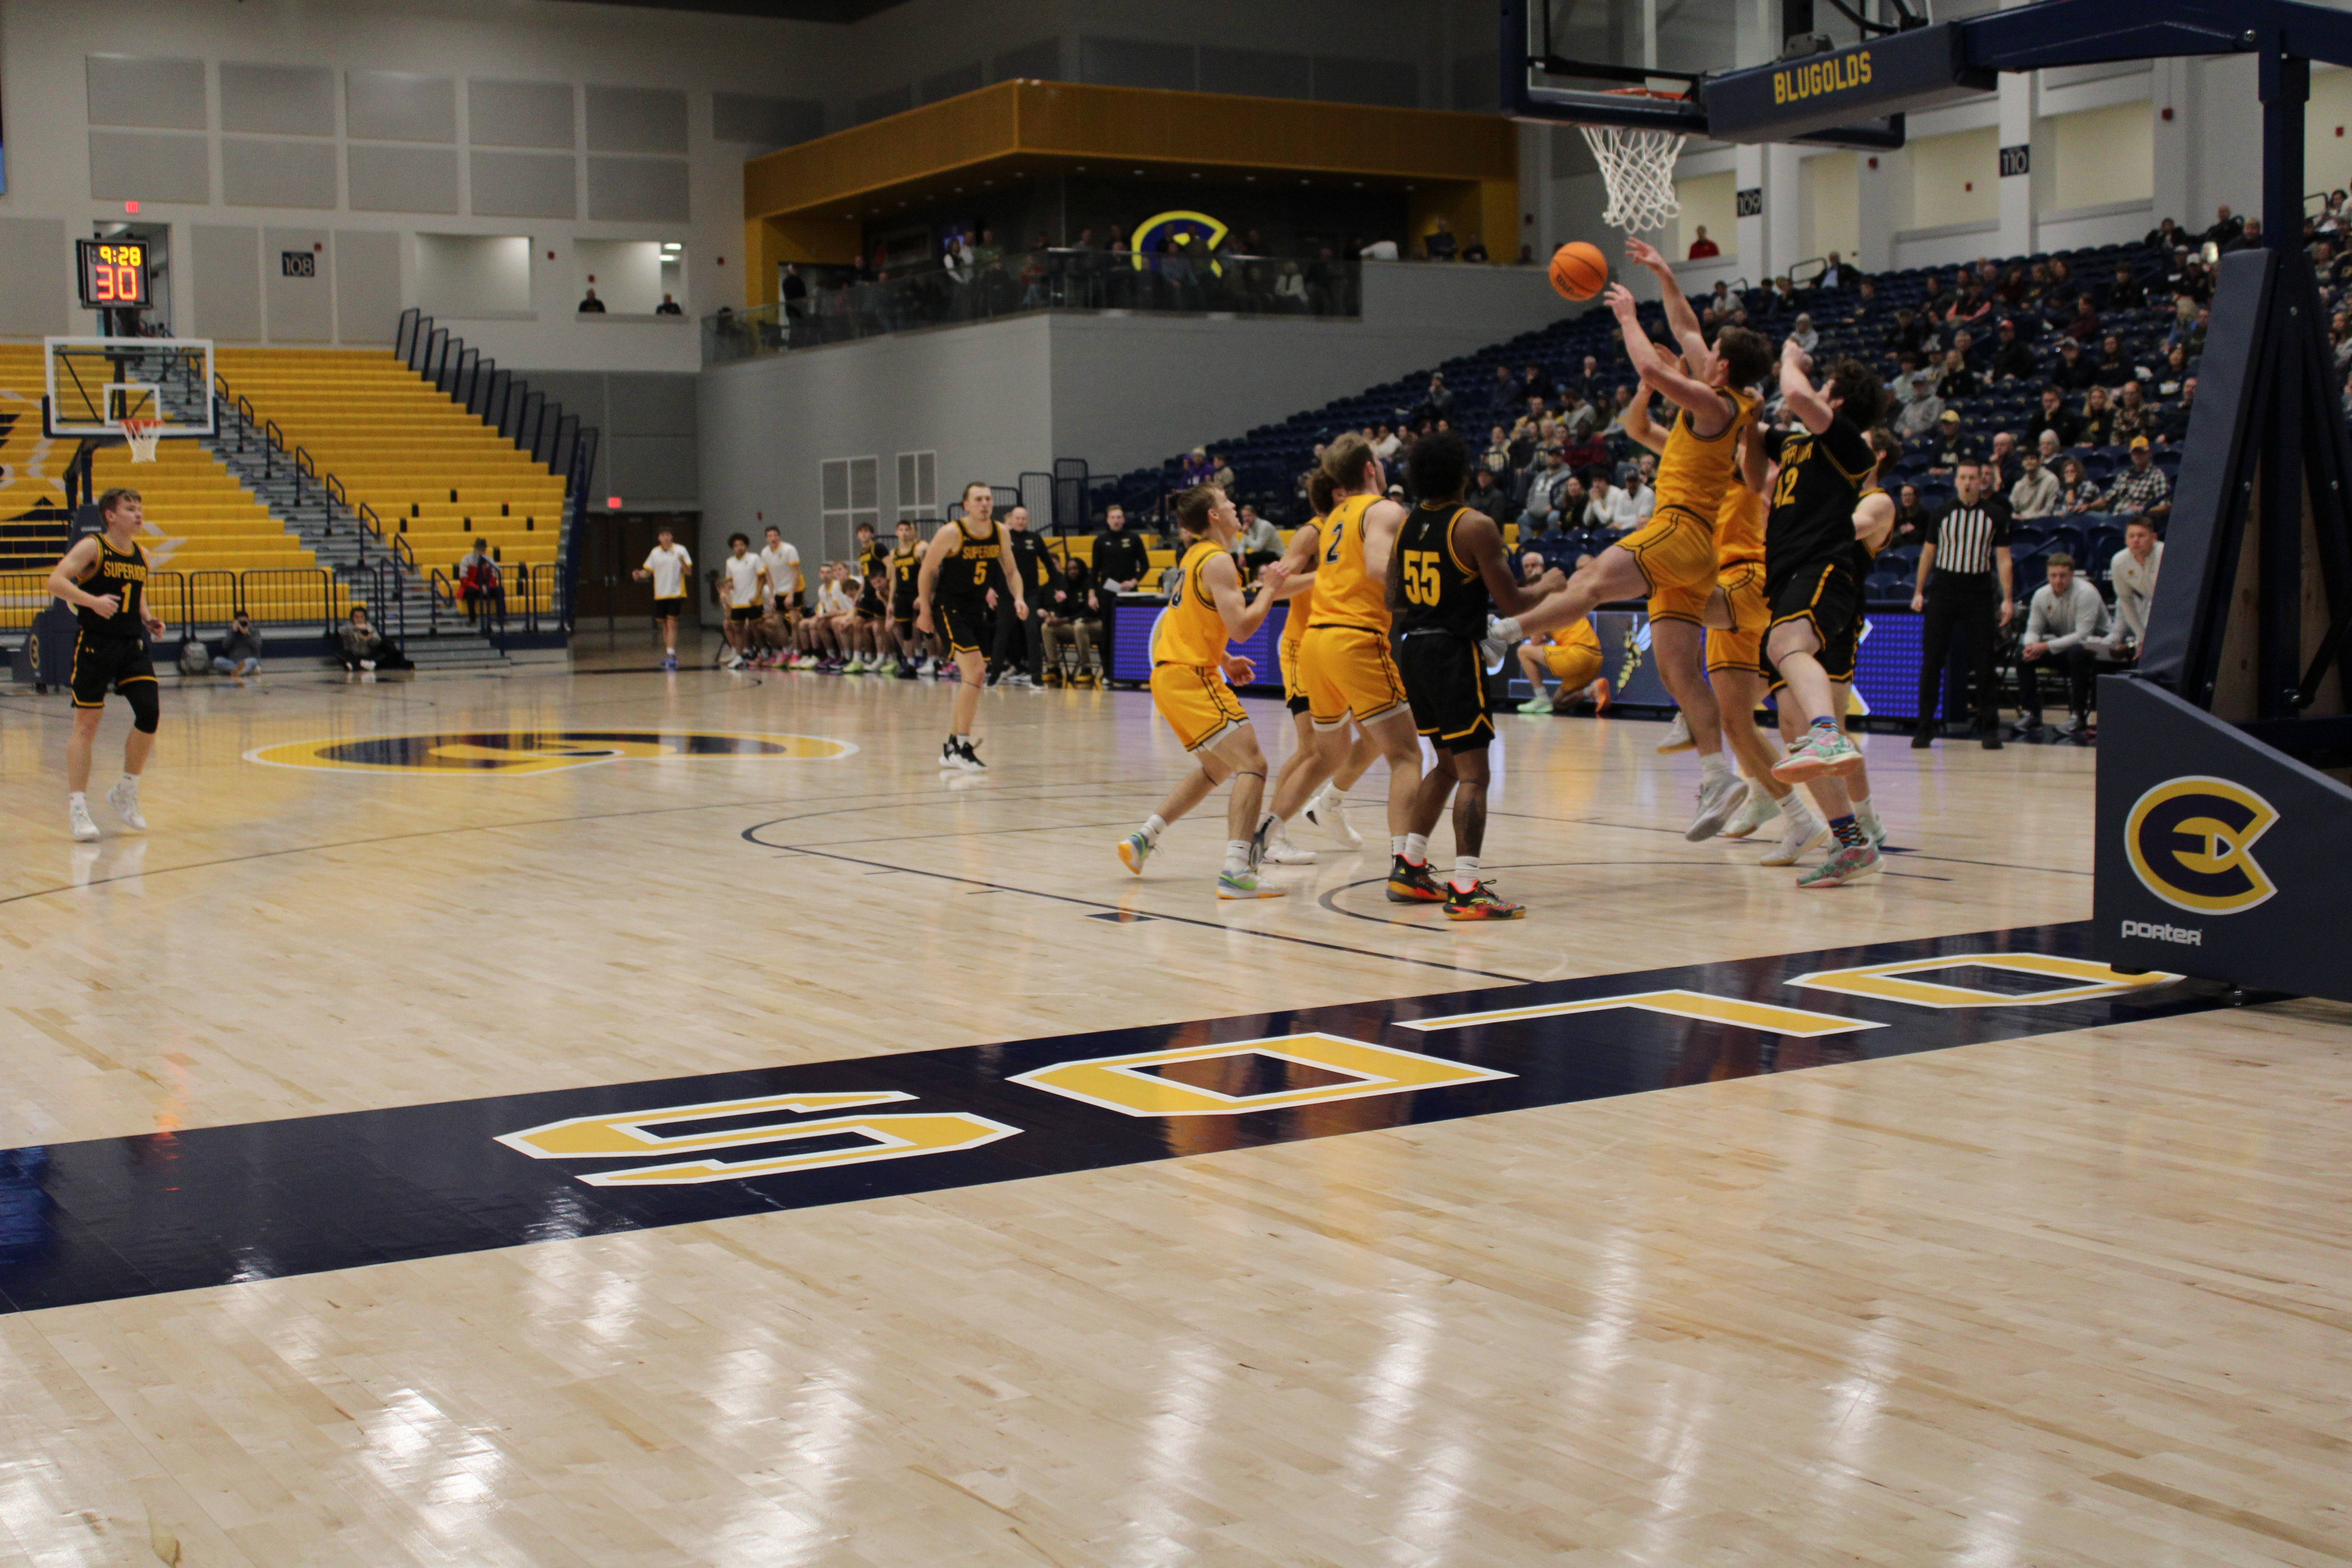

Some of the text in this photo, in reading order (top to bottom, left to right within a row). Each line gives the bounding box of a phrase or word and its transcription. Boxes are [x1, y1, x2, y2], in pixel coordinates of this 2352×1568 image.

[1774, 51, 1872, 105] BLUGOLDS
[2004, 152, 2027, 174] 110
[1739, 194, 1761, 214] 109
[100, 245, 141, 267] 9:28
[284, 256, 312, 275] 108
[96, 265, 138, 301] 30
[1326, 521, 1344, 564] 2
[103, 561, 147, 582] SUPERIOR
[973, 561, 988, 585] 5
[1404, 549, 1441, 607] 55
[121, 583, 132, 613] 1
